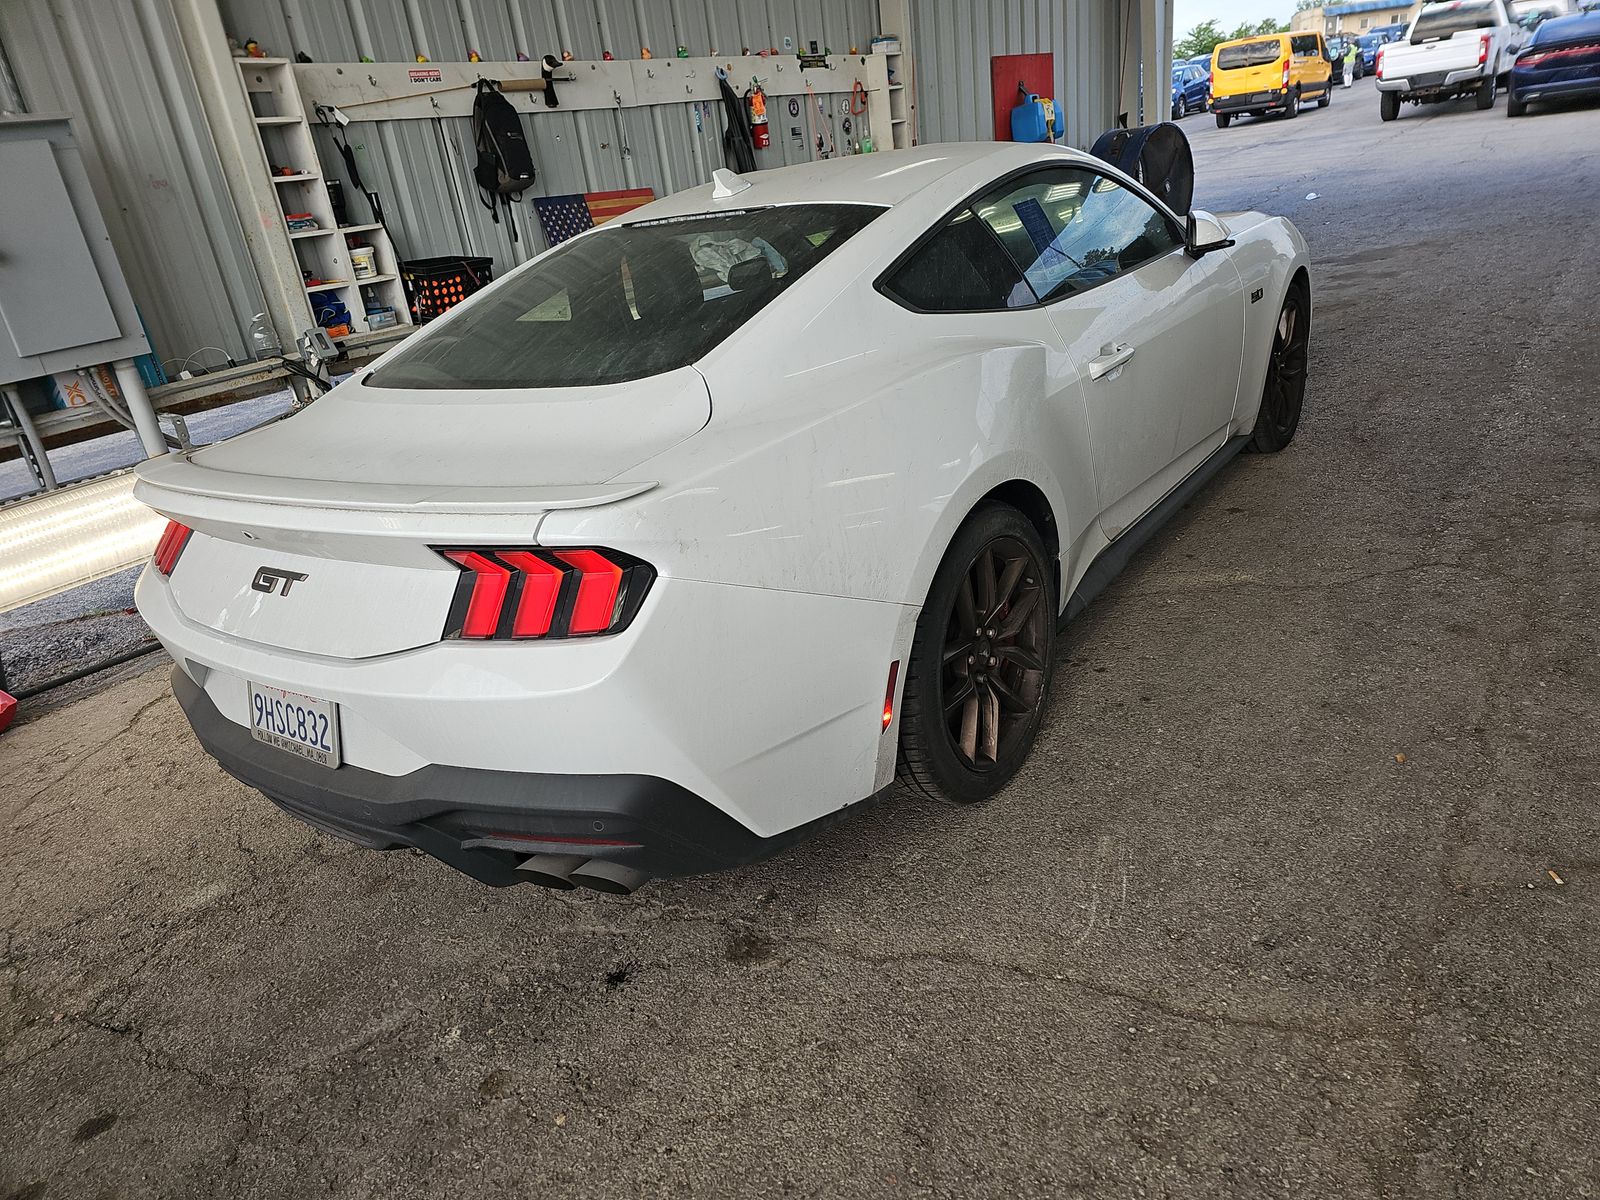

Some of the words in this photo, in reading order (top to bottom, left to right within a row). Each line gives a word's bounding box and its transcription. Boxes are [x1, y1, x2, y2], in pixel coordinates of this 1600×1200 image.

[251, 566, 309, 597] GT
[254, 693, 331, 752] 9HSC832
[257, 729, 273, 744] FOLLOW
[273, 734, 281, 747] ME
